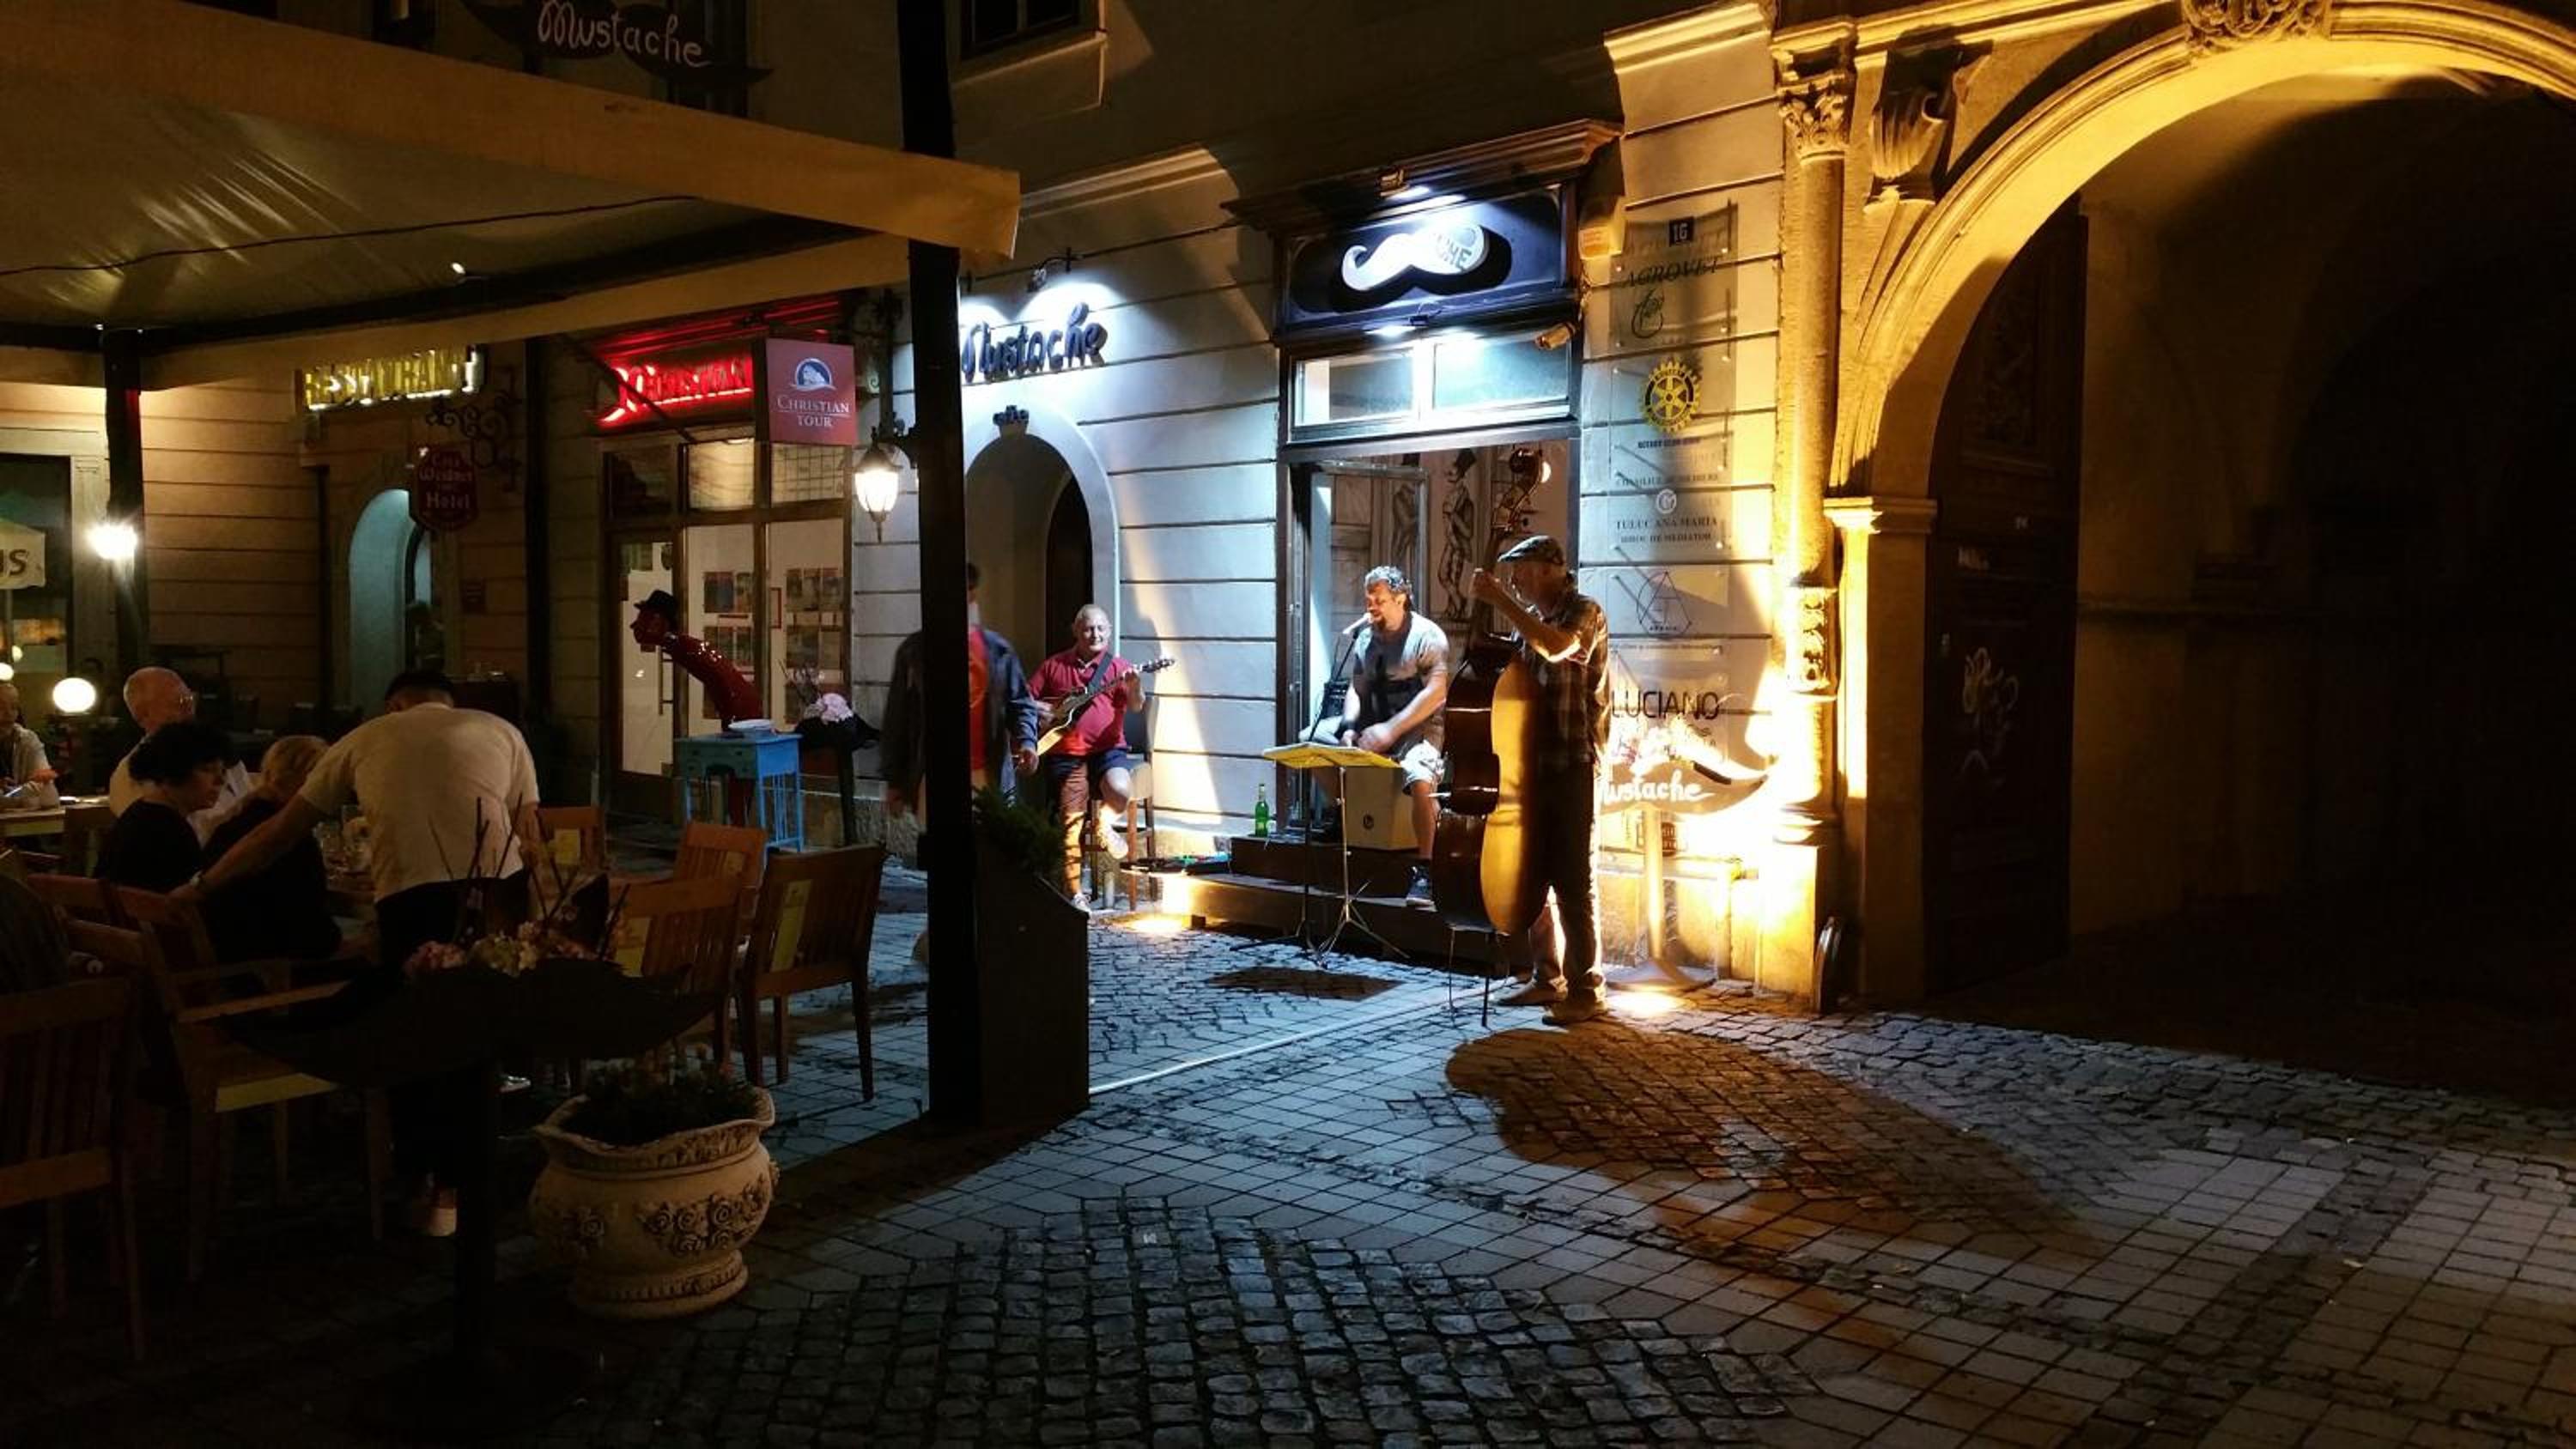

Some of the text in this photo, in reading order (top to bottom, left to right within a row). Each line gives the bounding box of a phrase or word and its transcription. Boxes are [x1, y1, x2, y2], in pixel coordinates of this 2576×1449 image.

[537, 0, 712, 67] Mustache
[1673, 223, 1689, 241] 16
[776, 394, 851, 414] CHRISTIAN
[796, 414, 833, 427] TOUR
[425, 490, 471, 509] Hotel
[1611, 689, 1720, 720] LUCIANO
